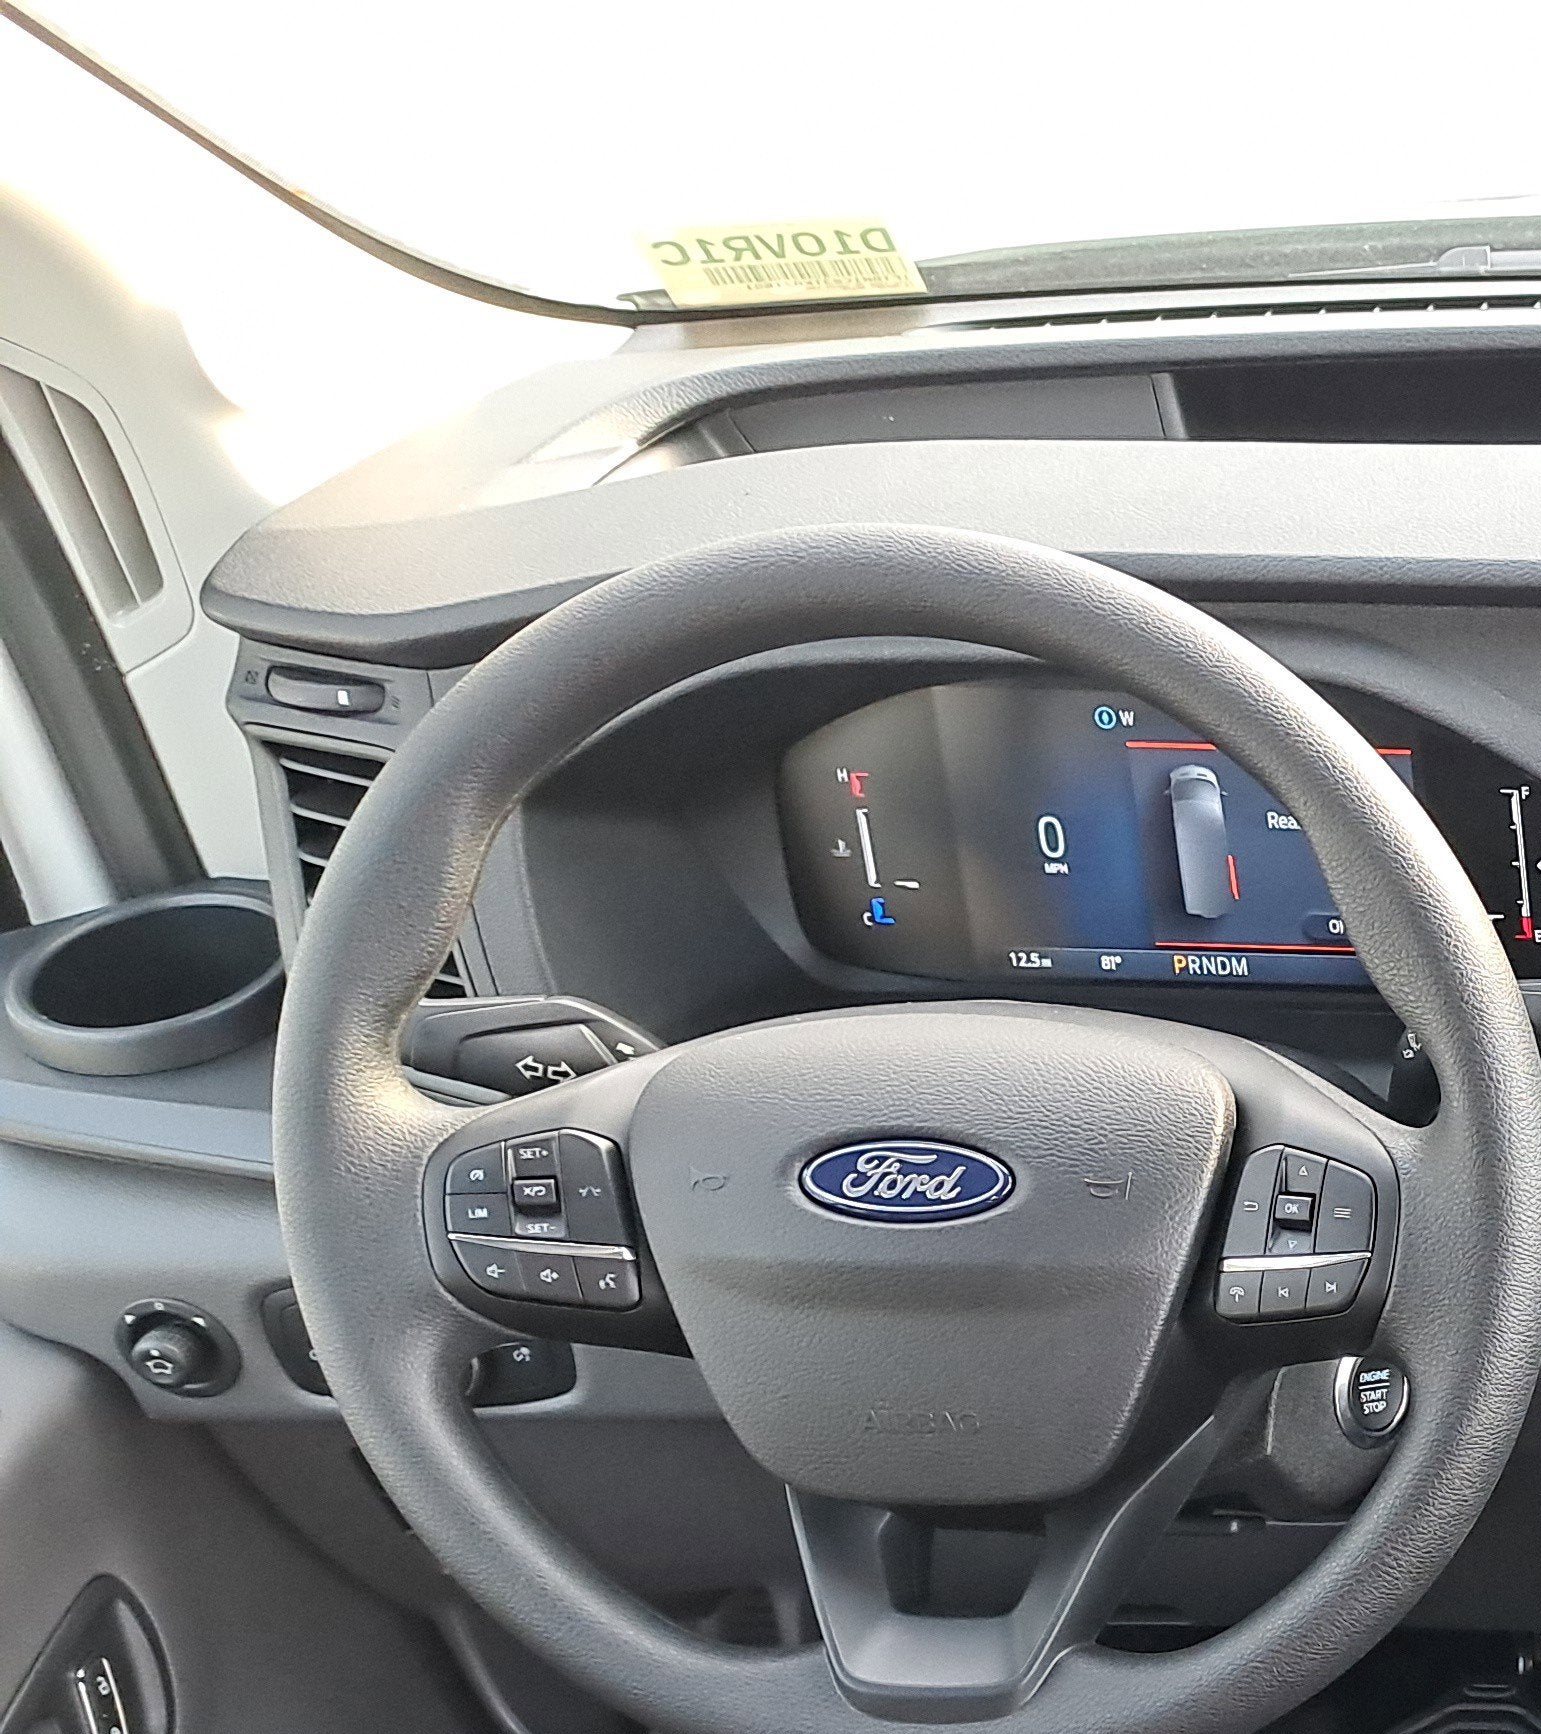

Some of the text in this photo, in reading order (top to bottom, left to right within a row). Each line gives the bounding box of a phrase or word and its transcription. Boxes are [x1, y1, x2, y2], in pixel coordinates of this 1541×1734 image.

[1118, 710, 1135, 726] W
[836, 767, 849, 783] H
[1521, 786, 1531, 800] F
[1266, 811, 1301, 829] Rea
[1037, 814, 1066, 859] 0
[1044, 862, 1070, 875] MPH
[841, 1150, 967, 1200] Ford
[1284, 1202, 1299, 1214] OK
[1360, 1388, 1388, 1402] START
[1363, 1401, 1387, 1415] STOP
